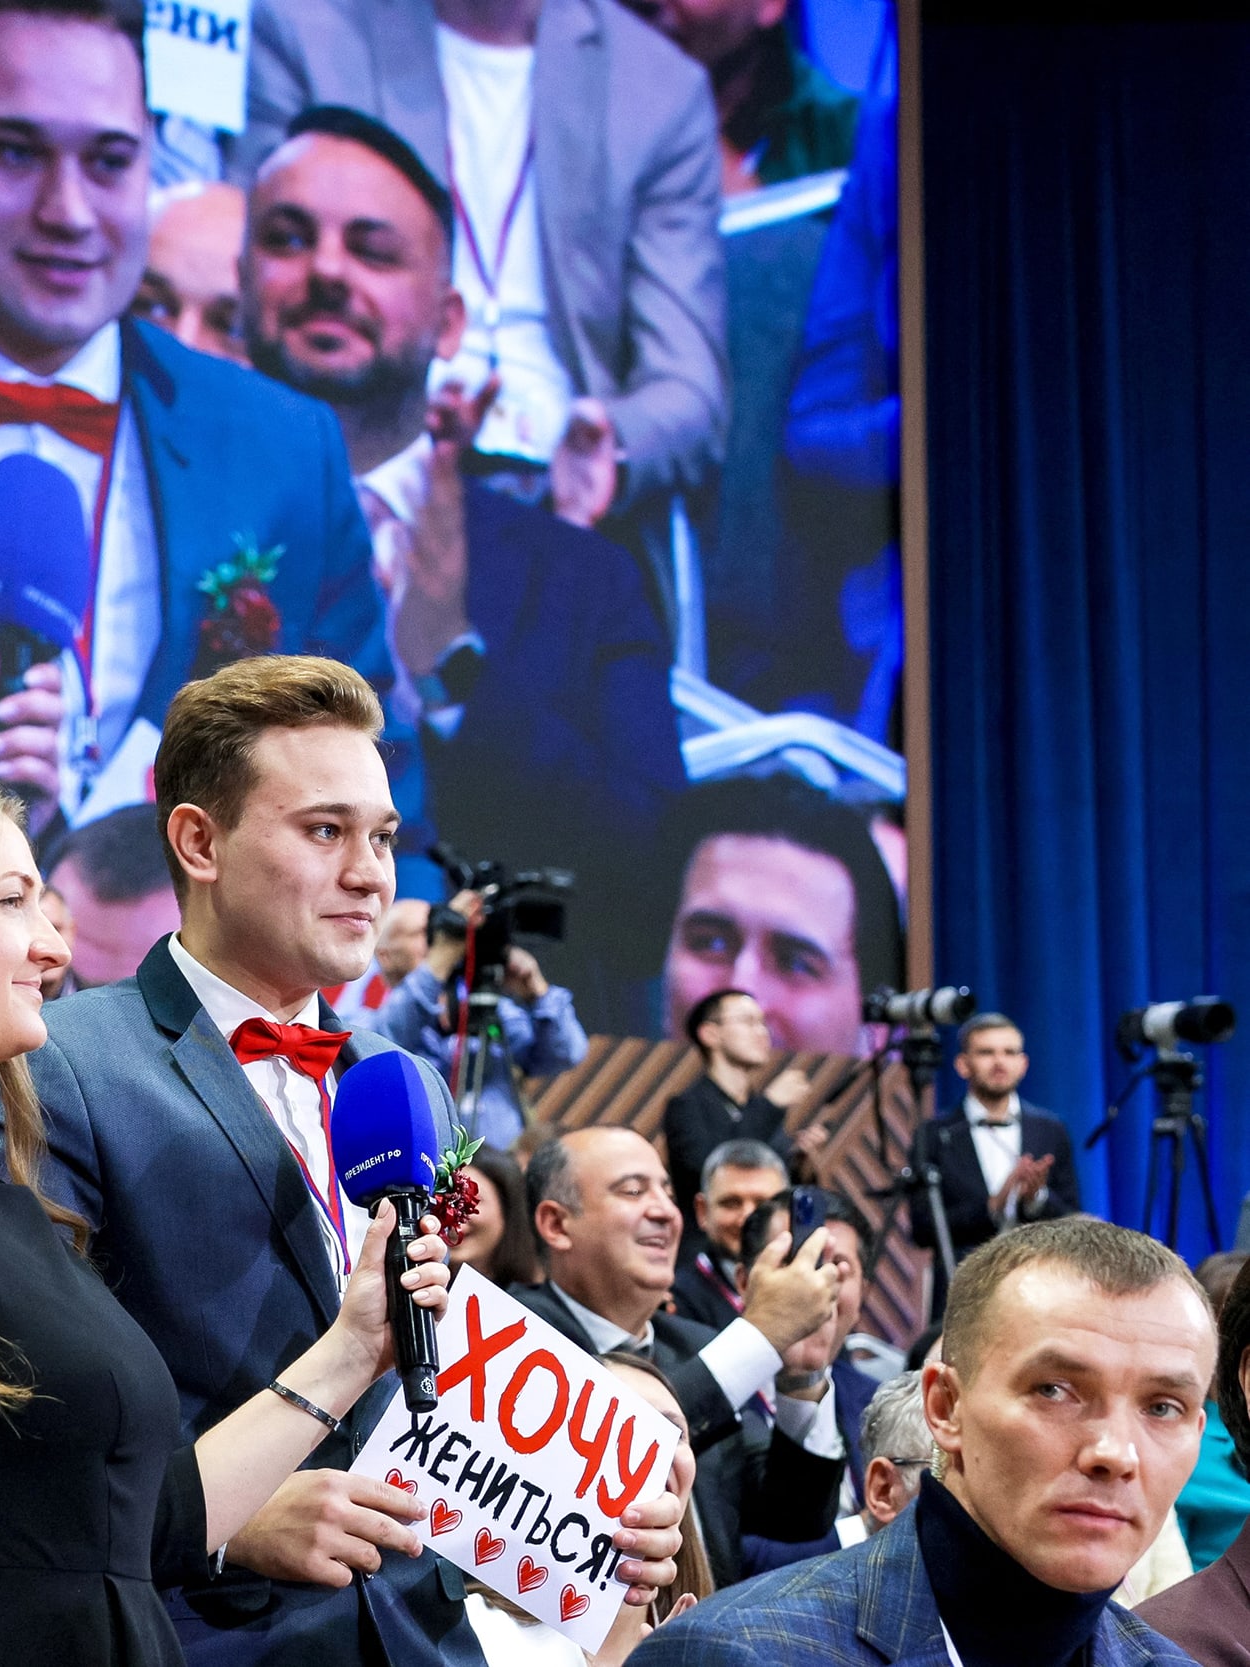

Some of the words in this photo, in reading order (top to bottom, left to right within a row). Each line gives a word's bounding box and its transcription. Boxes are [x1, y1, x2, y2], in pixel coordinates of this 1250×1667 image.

[344, 1153, 386, 1181] ПРЕЗИДЕНТ
[387, 1149, 402, 1160] РФ
[436, 1293, 660, 1518] ХОЧУ
[389, 1411, 623, 1591] ЖЕНИТЬСЯ!
